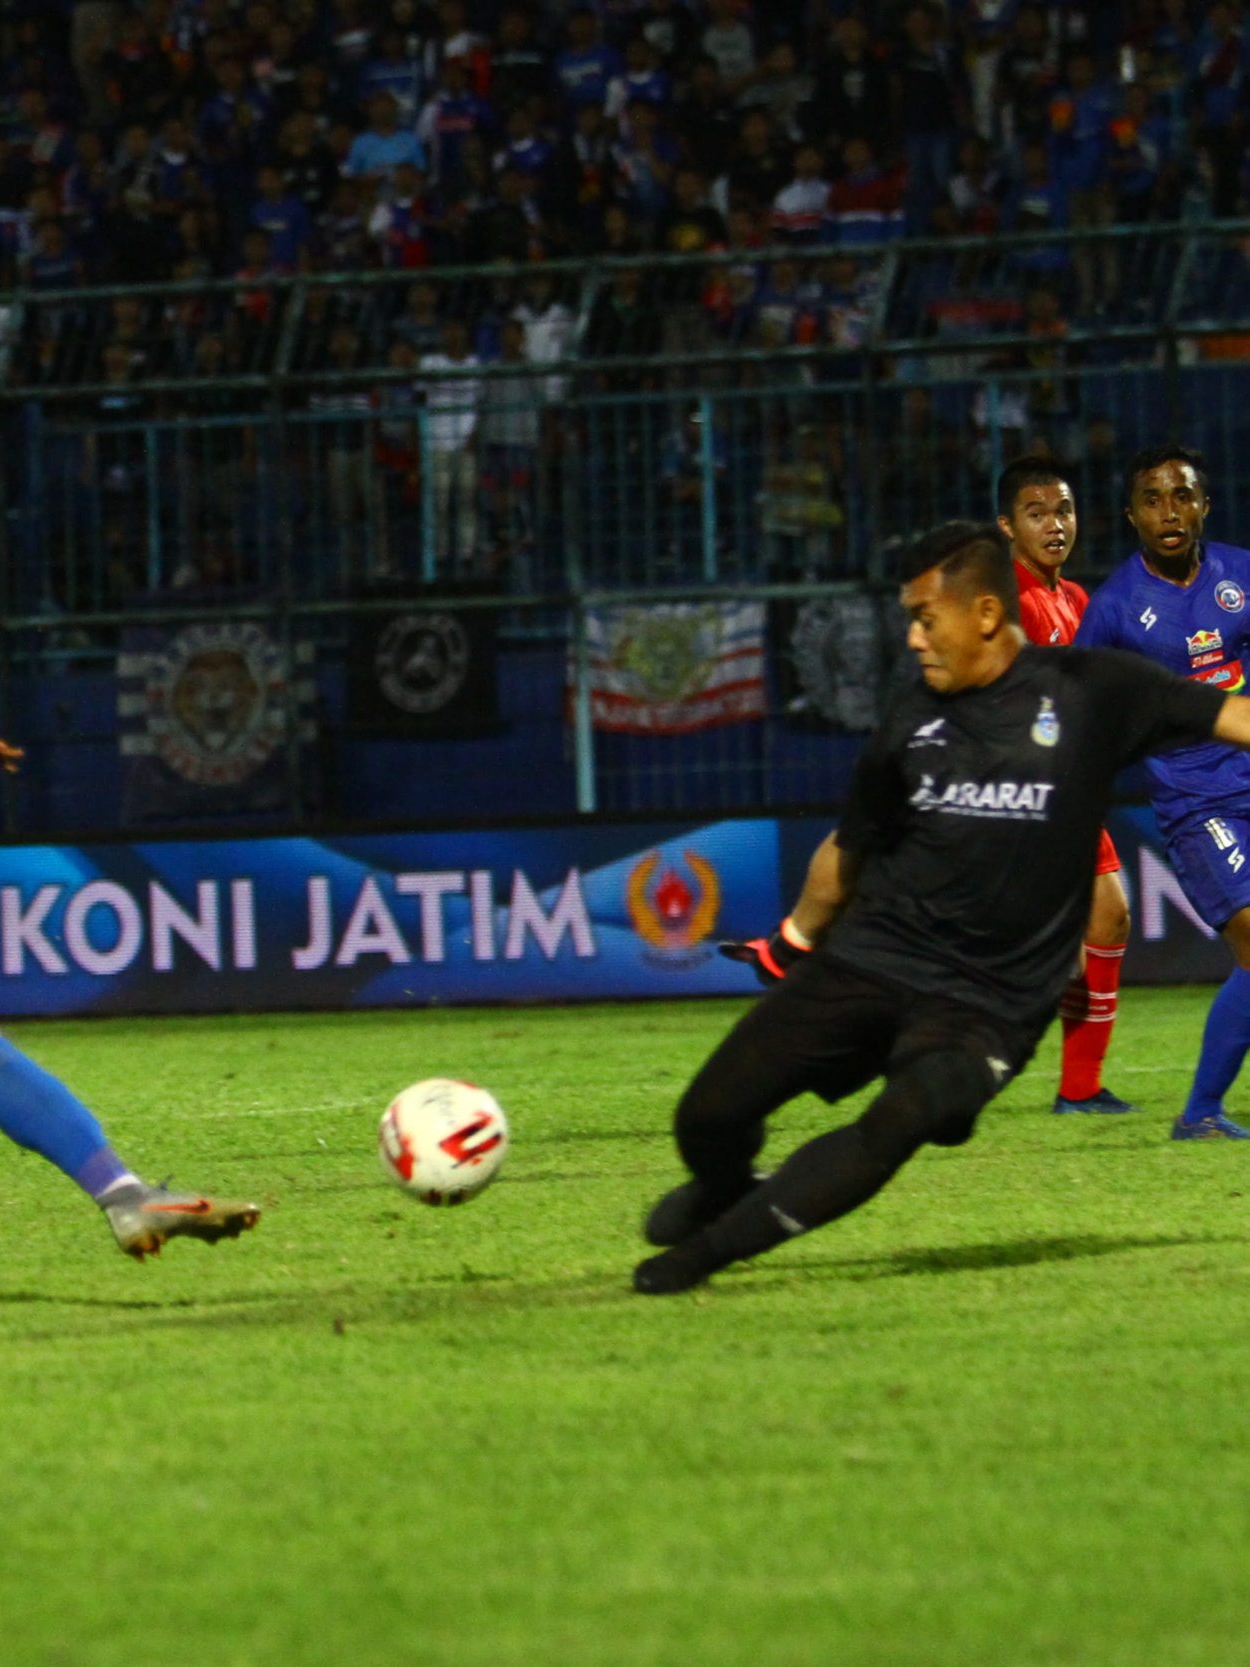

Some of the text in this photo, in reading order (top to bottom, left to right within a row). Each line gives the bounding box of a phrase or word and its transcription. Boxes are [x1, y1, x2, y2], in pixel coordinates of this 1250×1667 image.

[941, 782, 1055, 811] ARARAT
[0, 866, 596, 976] KONI JATIM
